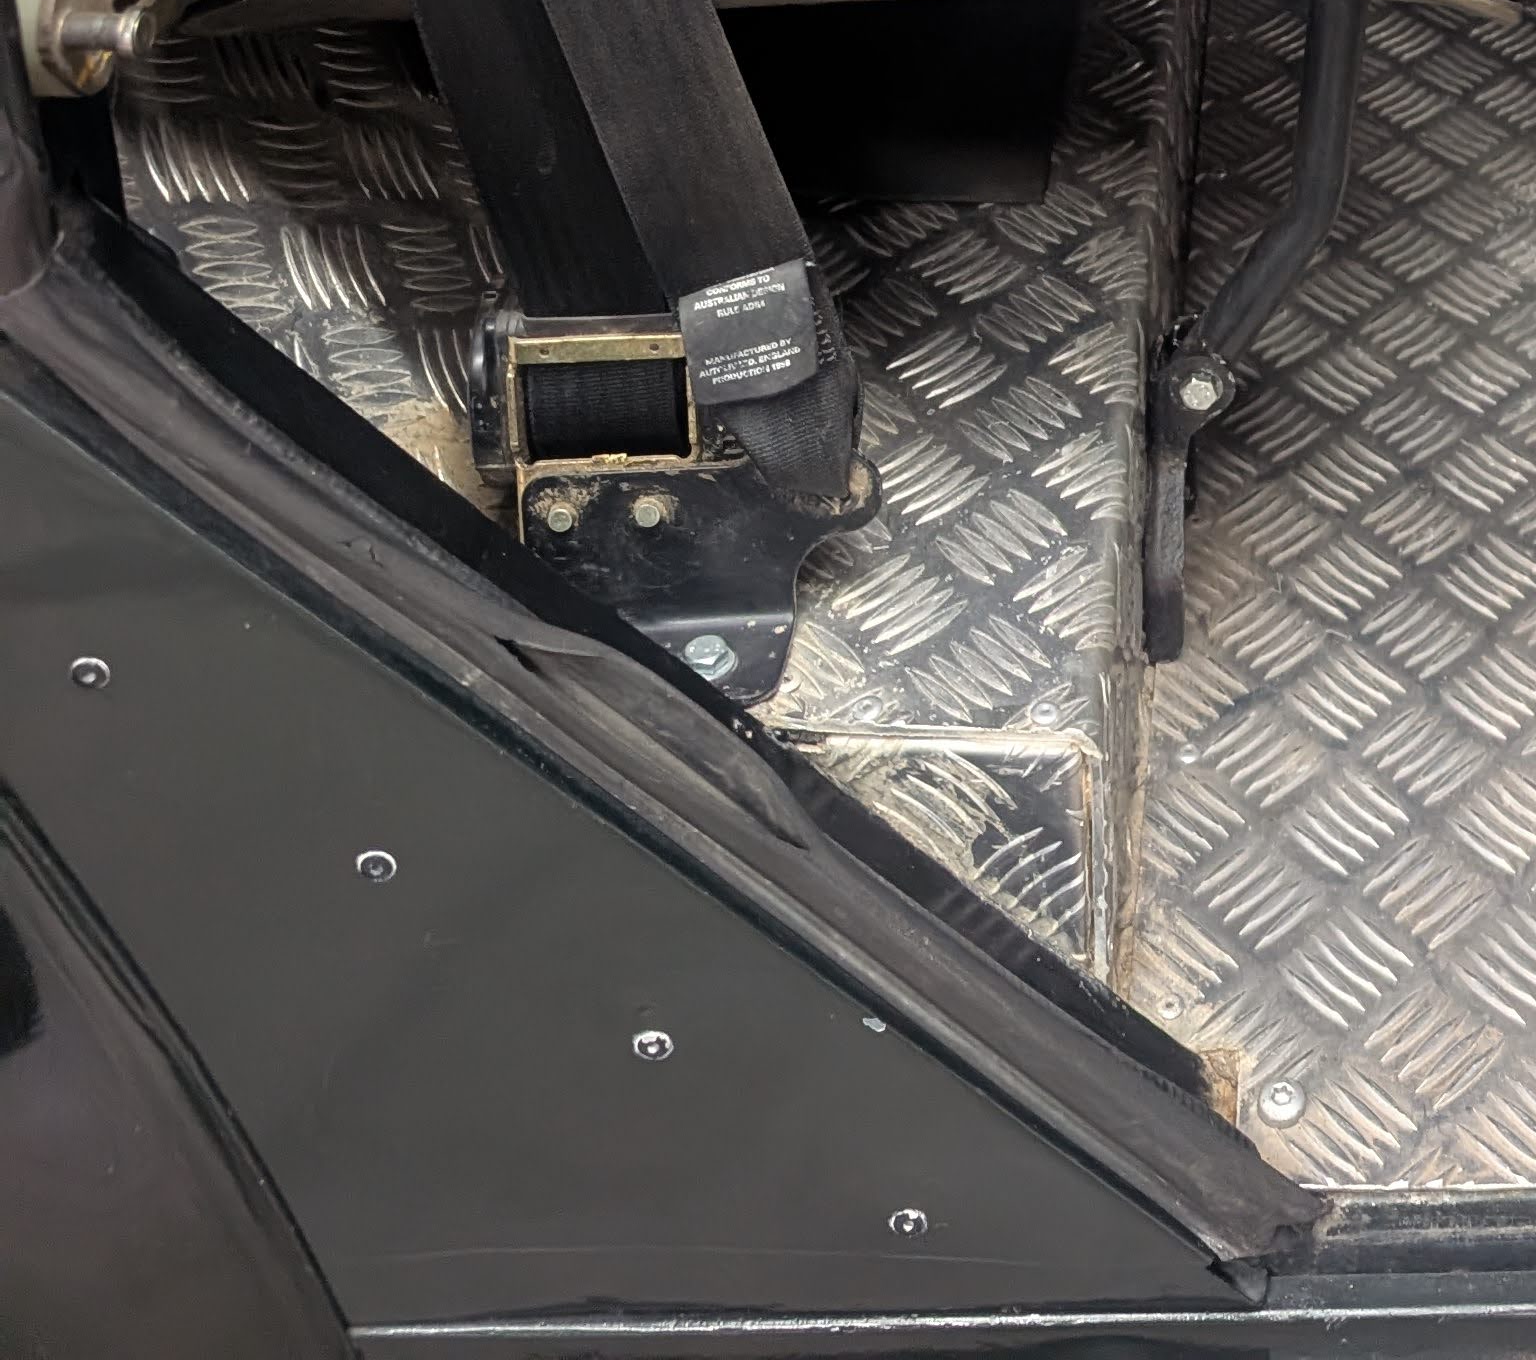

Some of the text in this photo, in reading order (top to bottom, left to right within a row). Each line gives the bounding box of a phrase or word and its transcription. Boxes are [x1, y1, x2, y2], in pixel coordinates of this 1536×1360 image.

[757, 275, 771, 284] TO
[694, 290, 750, 311] AUSTRALIAN
[716, 307, 740, 318] RULE
[705, 337, 792, 366] MANUFACTURED BY
[758, 346, 801, 364] ENGLAND
[712, 364, 771, 385] PRODUCTION
